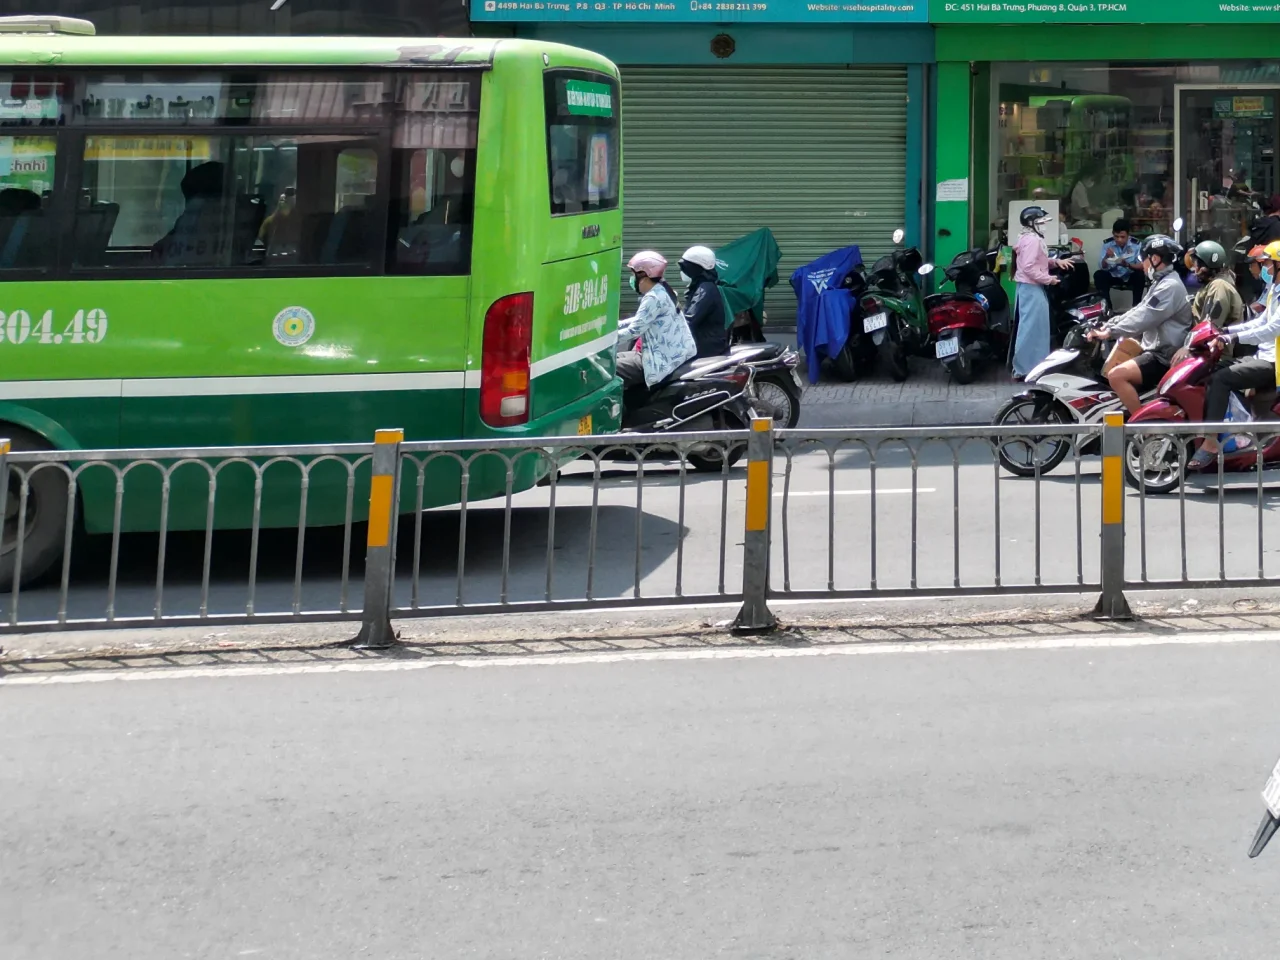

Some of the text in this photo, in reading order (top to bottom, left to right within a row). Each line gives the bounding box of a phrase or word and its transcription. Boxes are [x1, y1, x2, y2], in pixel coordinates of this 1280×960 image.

[519, 2, 533, 10] Hai
[594, 2, 605, 11] Q3
[654, 2, 675, 10] Minh
[807, 3, 914, 12] Website: visehospitality.com
[960, 3, 974, 11] 451
[977, 3, 990, 11] Hai
[1219, 4, 1251, 12] Website:
[0, 309, 107, 344] 04.49
